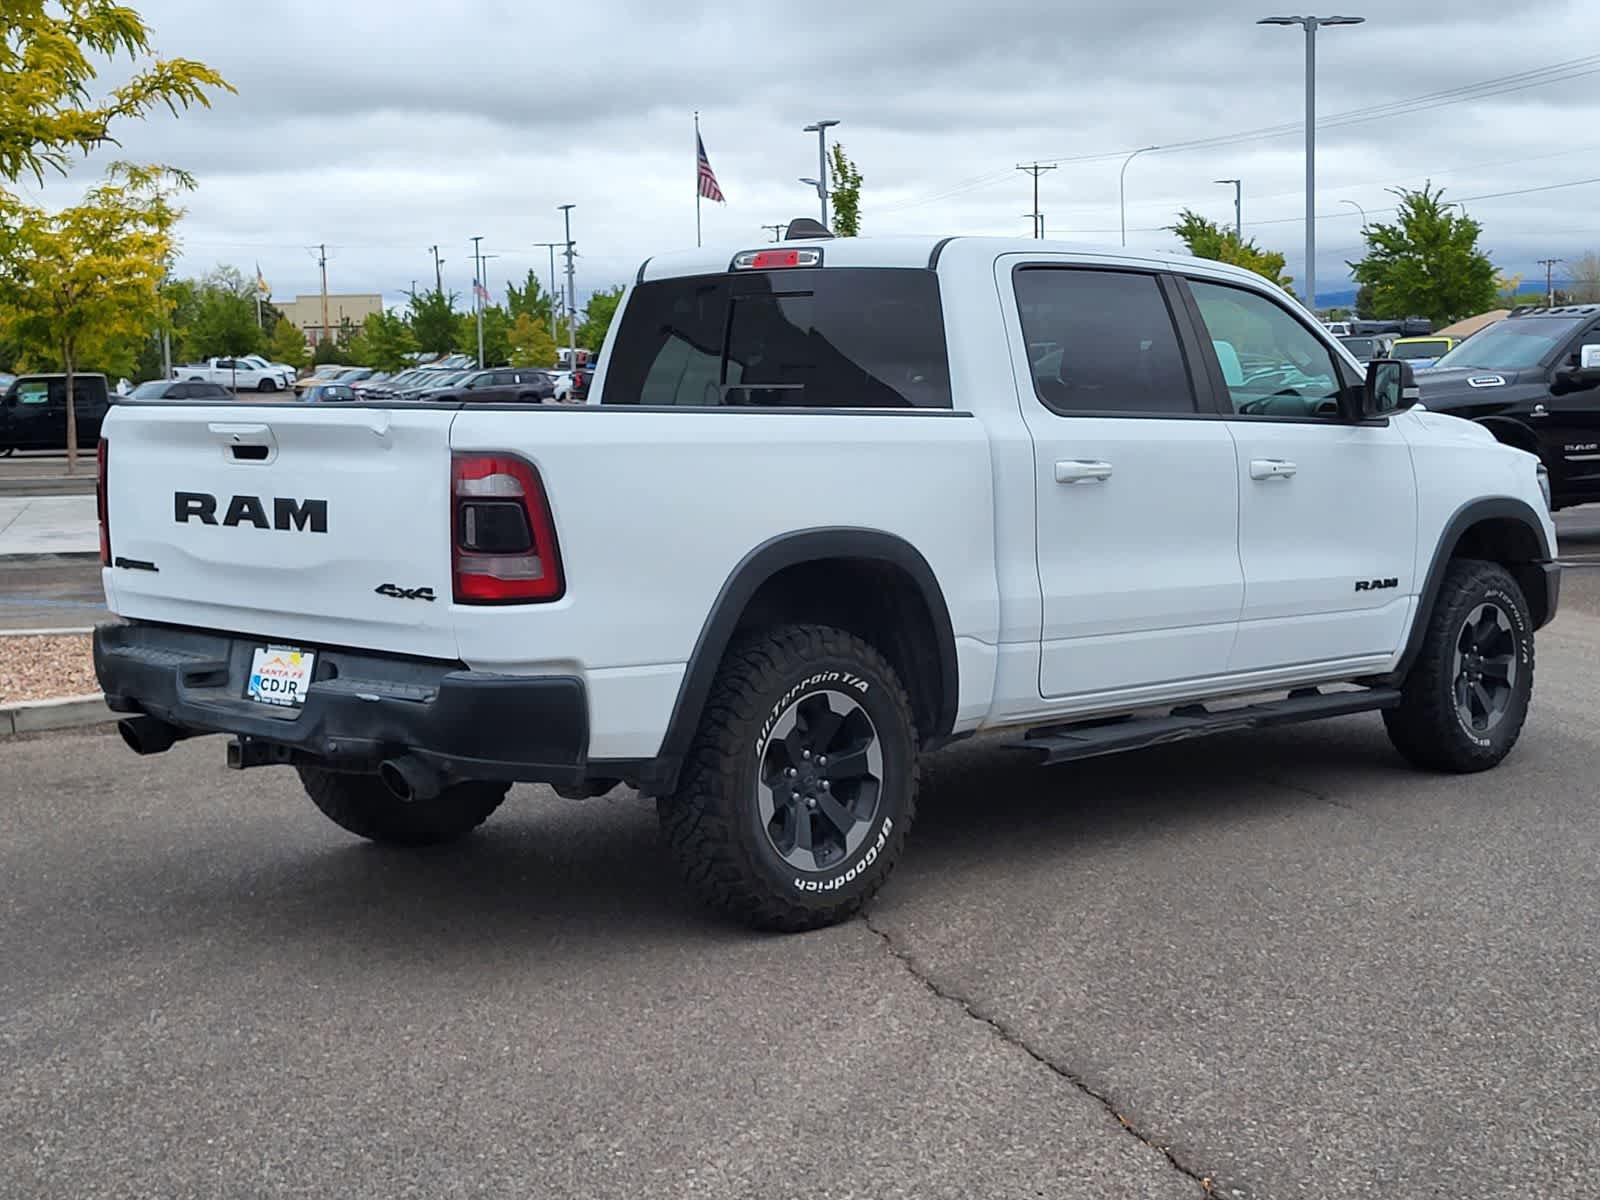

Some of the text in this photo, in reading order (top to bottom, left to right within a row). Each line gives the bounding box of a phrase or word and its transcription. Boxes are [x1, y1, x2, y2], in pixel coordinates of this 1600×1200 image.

[174, 491, 329, 534] RAM
[375, 583, 437, 602] 4x4
[1355, 577, 1398, 592] RAM
[260, 677, 298, 695] CDJR
[756, 671, 869, 758] All-Terrain T/A
[793, 816, 894, 893] BFGoodrich
